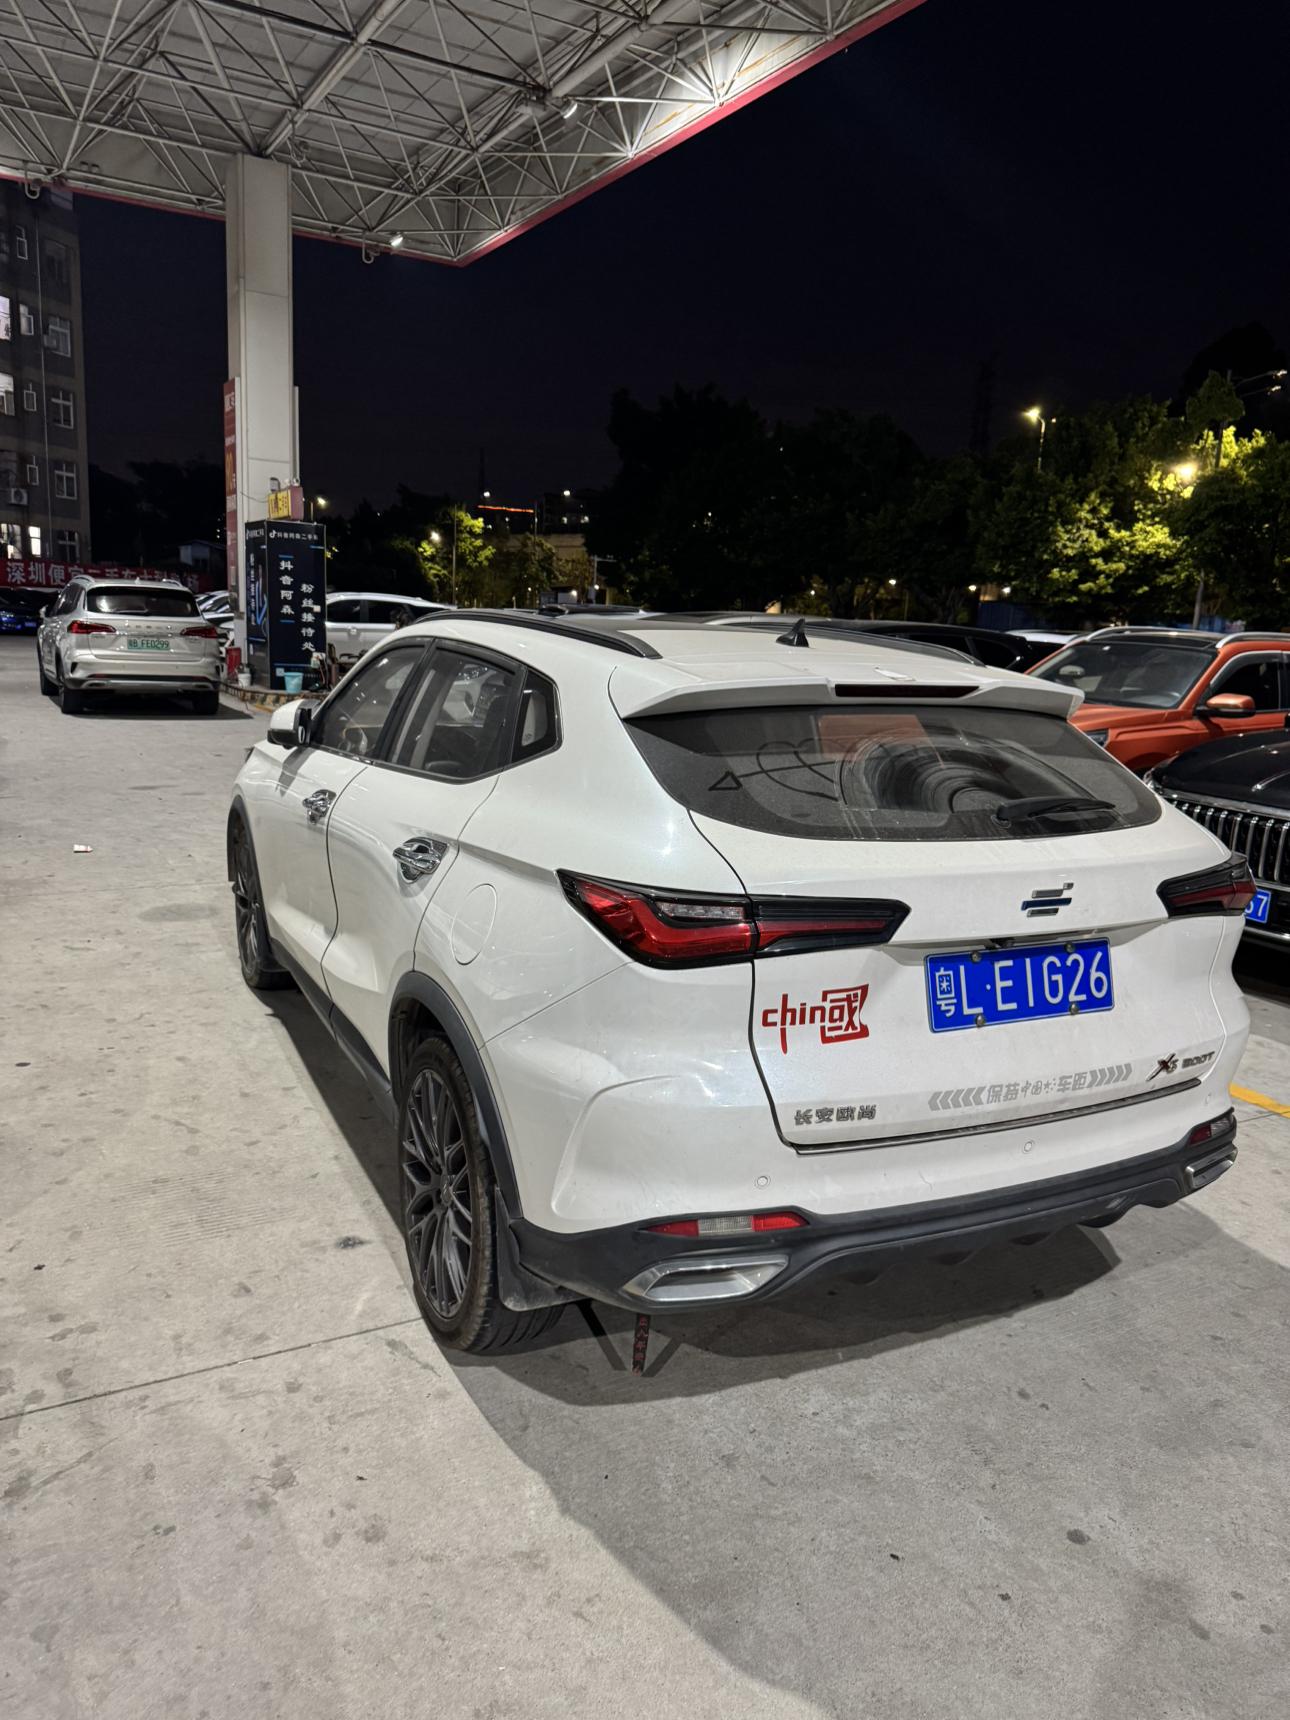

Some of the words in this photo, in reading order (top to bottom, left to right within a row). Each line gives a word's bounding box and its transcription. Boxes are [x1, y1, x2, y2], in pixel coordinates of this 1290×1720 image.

[301, 583, 316, 651] 粉丝接待处
[794, 1104, 877, 1126] 长安欧尚
